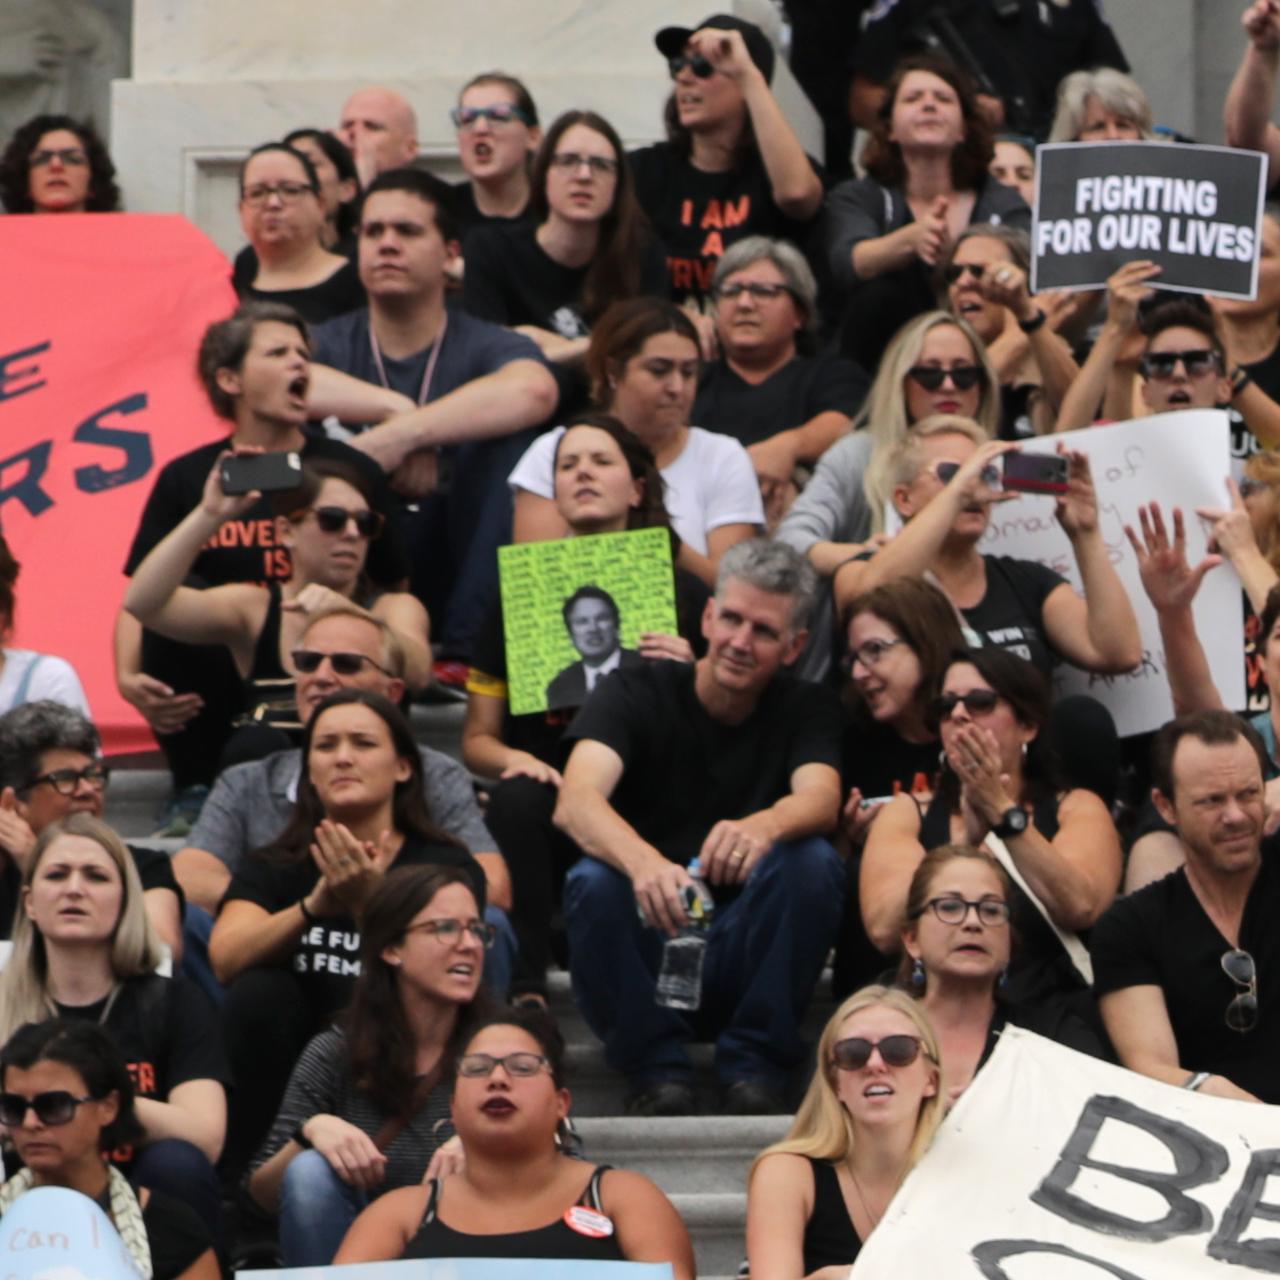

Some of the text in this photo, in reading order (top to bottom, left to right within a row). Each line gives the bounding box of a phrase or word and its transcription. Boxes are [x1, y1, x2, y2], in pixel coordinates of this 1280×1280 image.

[1074, 174, 1218, 217] FIGHTING
[1036, 213, 1255, 263] FOR OUR LIVES
[0, 339, 52, 402] E
[0, 392, 154, 518] RS
[328, 930, 361, 952] FU
[313, 952, 362, 977] FEM
